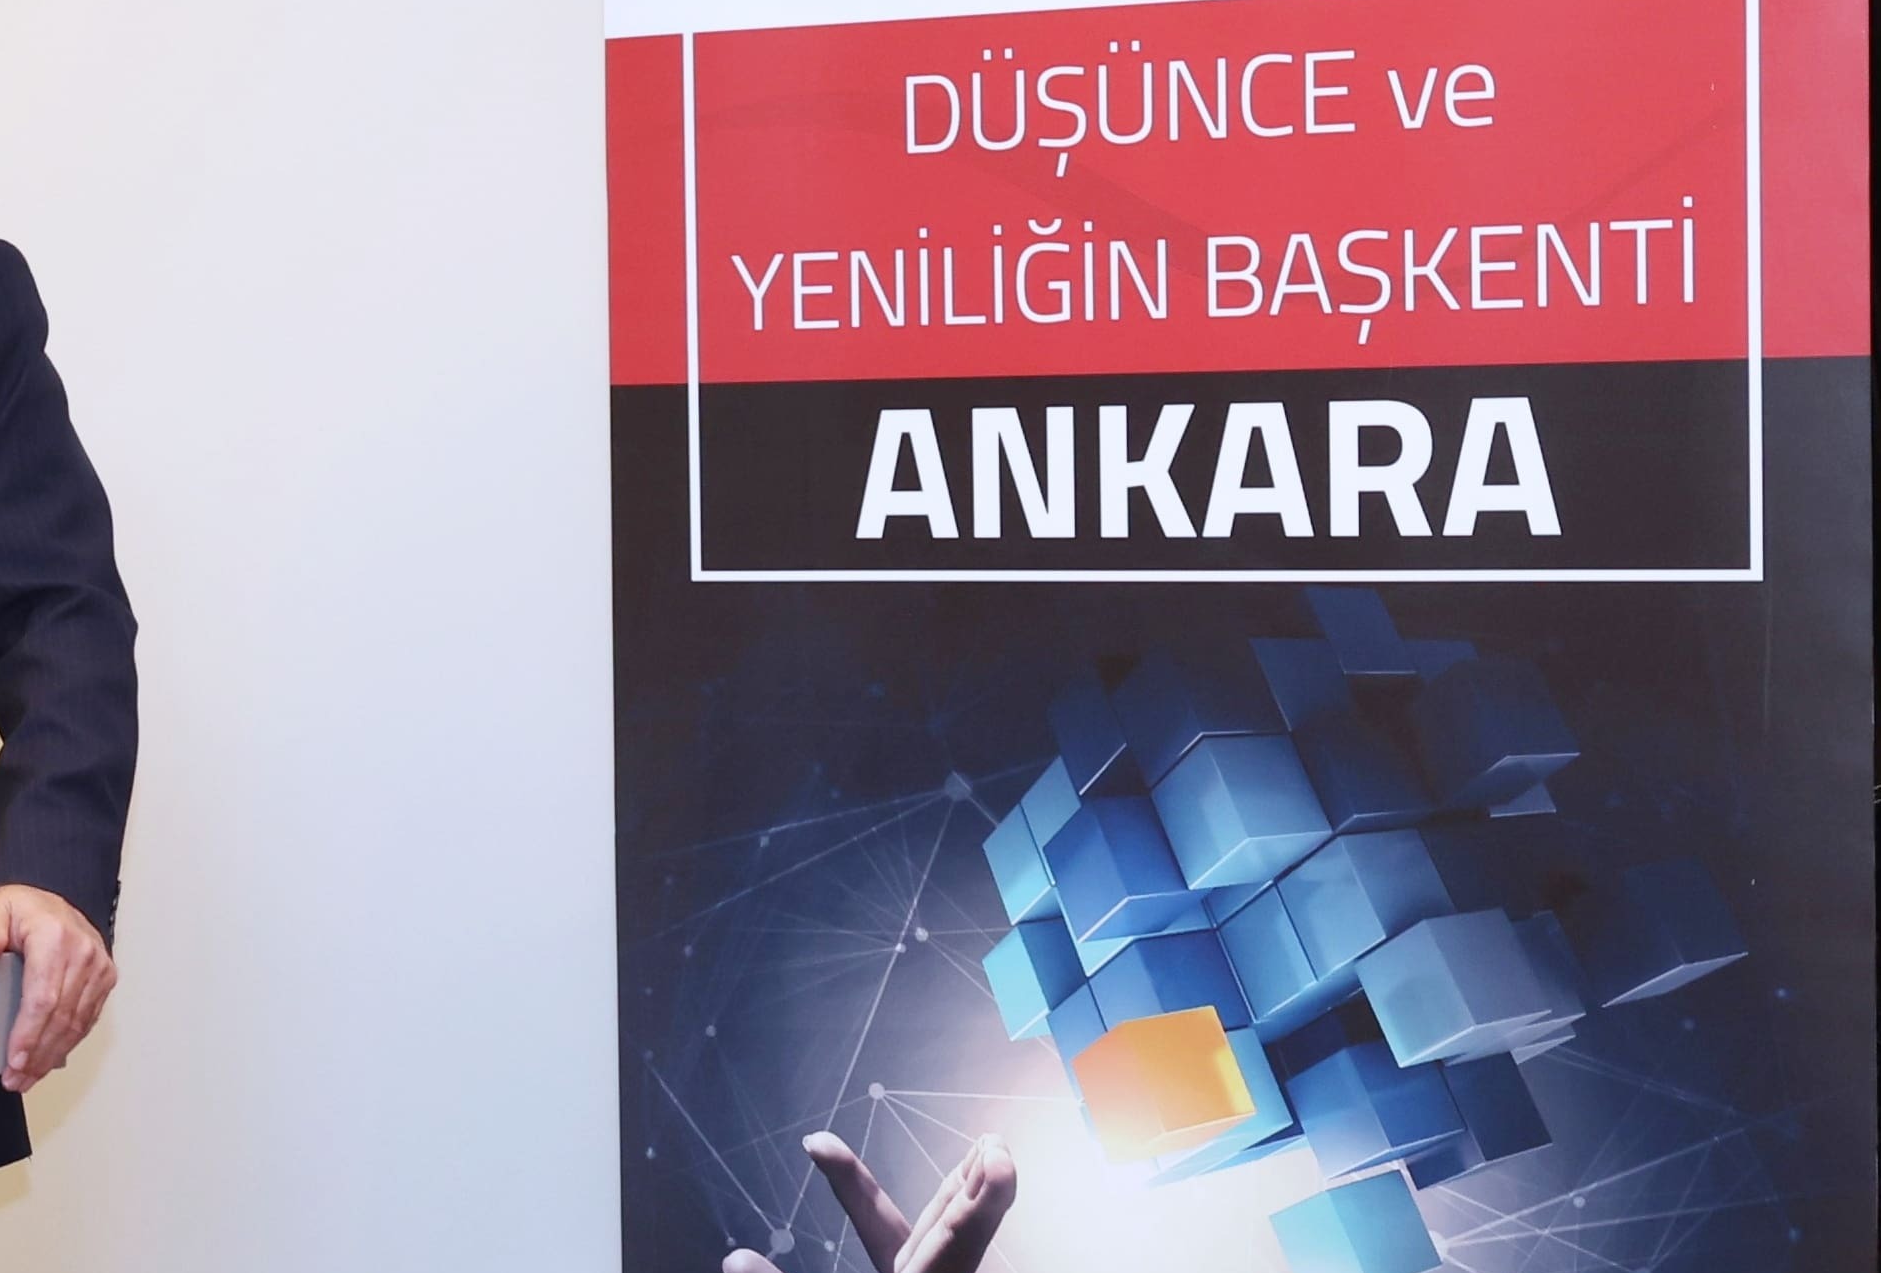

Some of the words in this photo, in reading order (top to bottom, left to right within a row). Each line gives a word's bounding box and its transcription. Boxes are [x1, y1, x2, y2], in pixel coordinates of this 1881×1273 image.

[906, 41, 1355, 177] DÜŞÜNCE
[1388, 65, 1494, 128] ve
[732, 219, 1166, 330] YENİLİĞİN
[1208, 196, 1693, 344] BAŞKENTİ
[856, 397, 1561, 538] ANKARA
